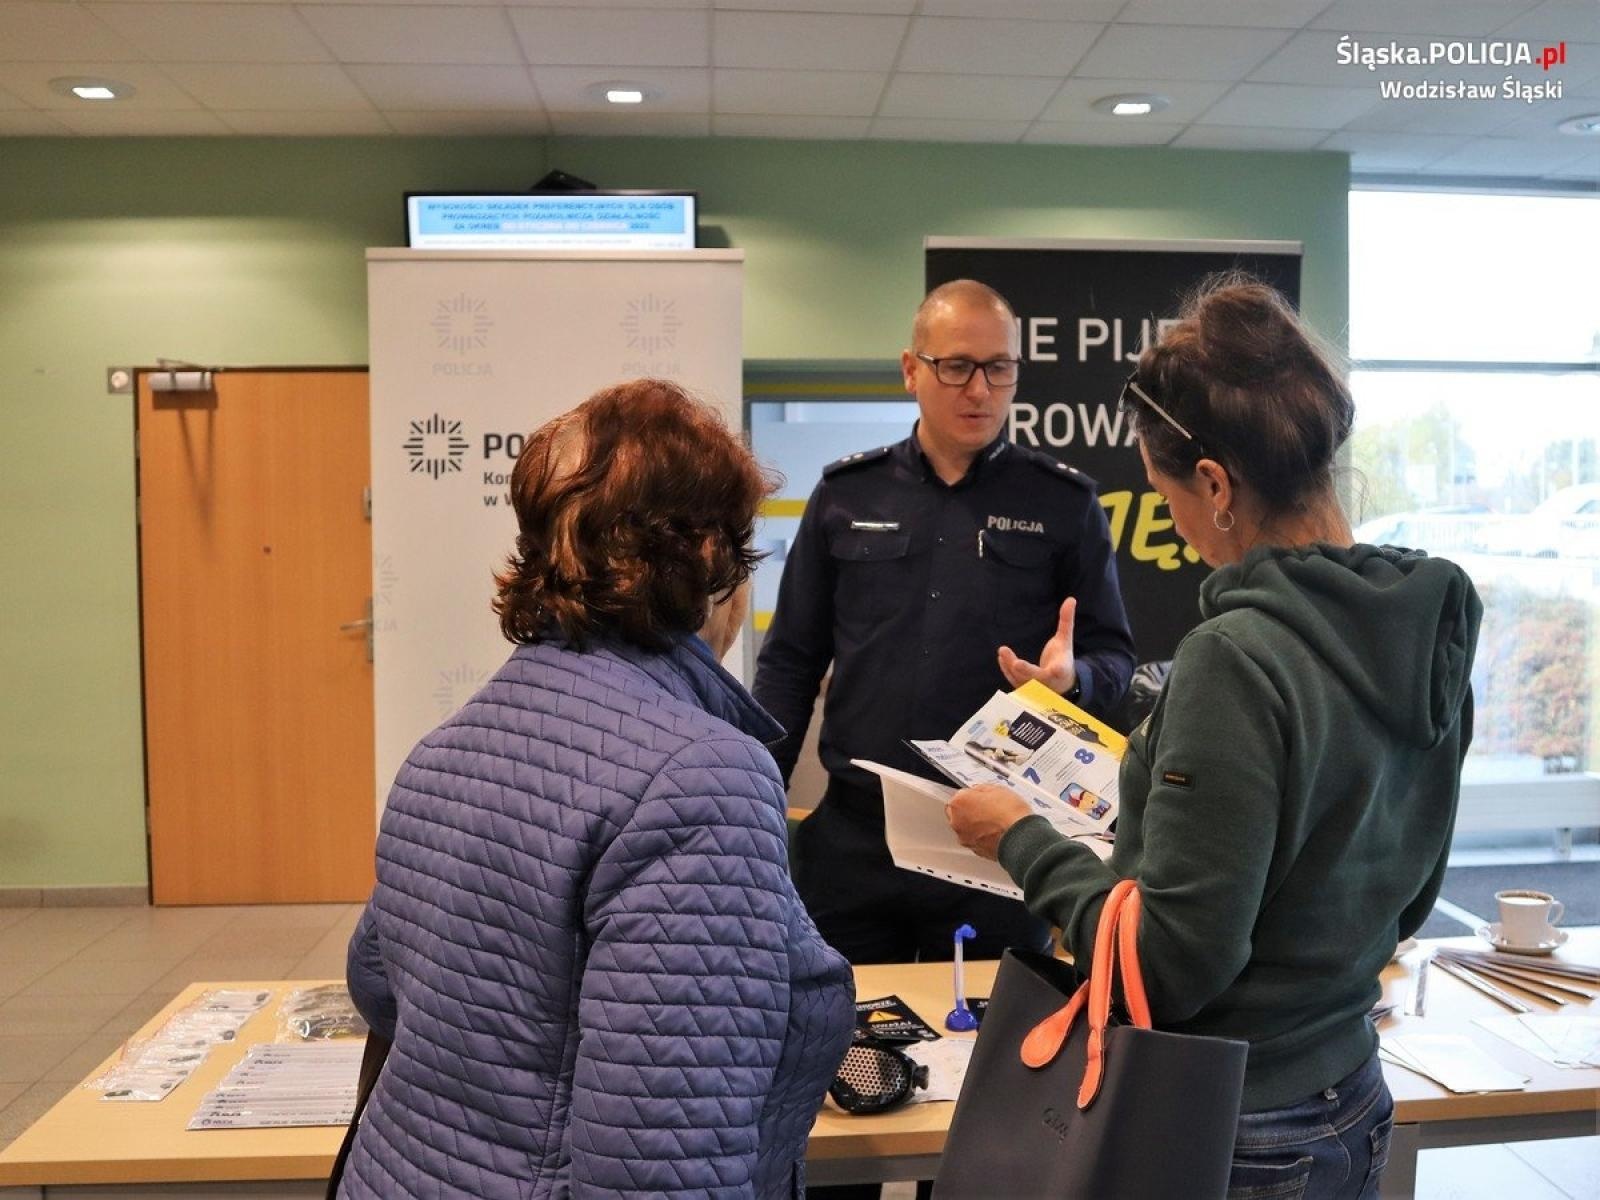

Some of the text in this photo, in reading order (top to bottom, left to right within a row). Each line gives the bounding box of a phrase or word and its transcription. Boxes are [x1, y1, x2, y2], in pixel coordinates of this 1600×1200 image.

[432, 362, 494, 376] POLICJA
[621, 362, 681, 376] POLICJA
[483, 432, 525, 460] PO
[987, 515, 1044, 534] POLICJA
[1074, 748, 1095, 764] 8
[1022, 767, 1041, 784] 7
